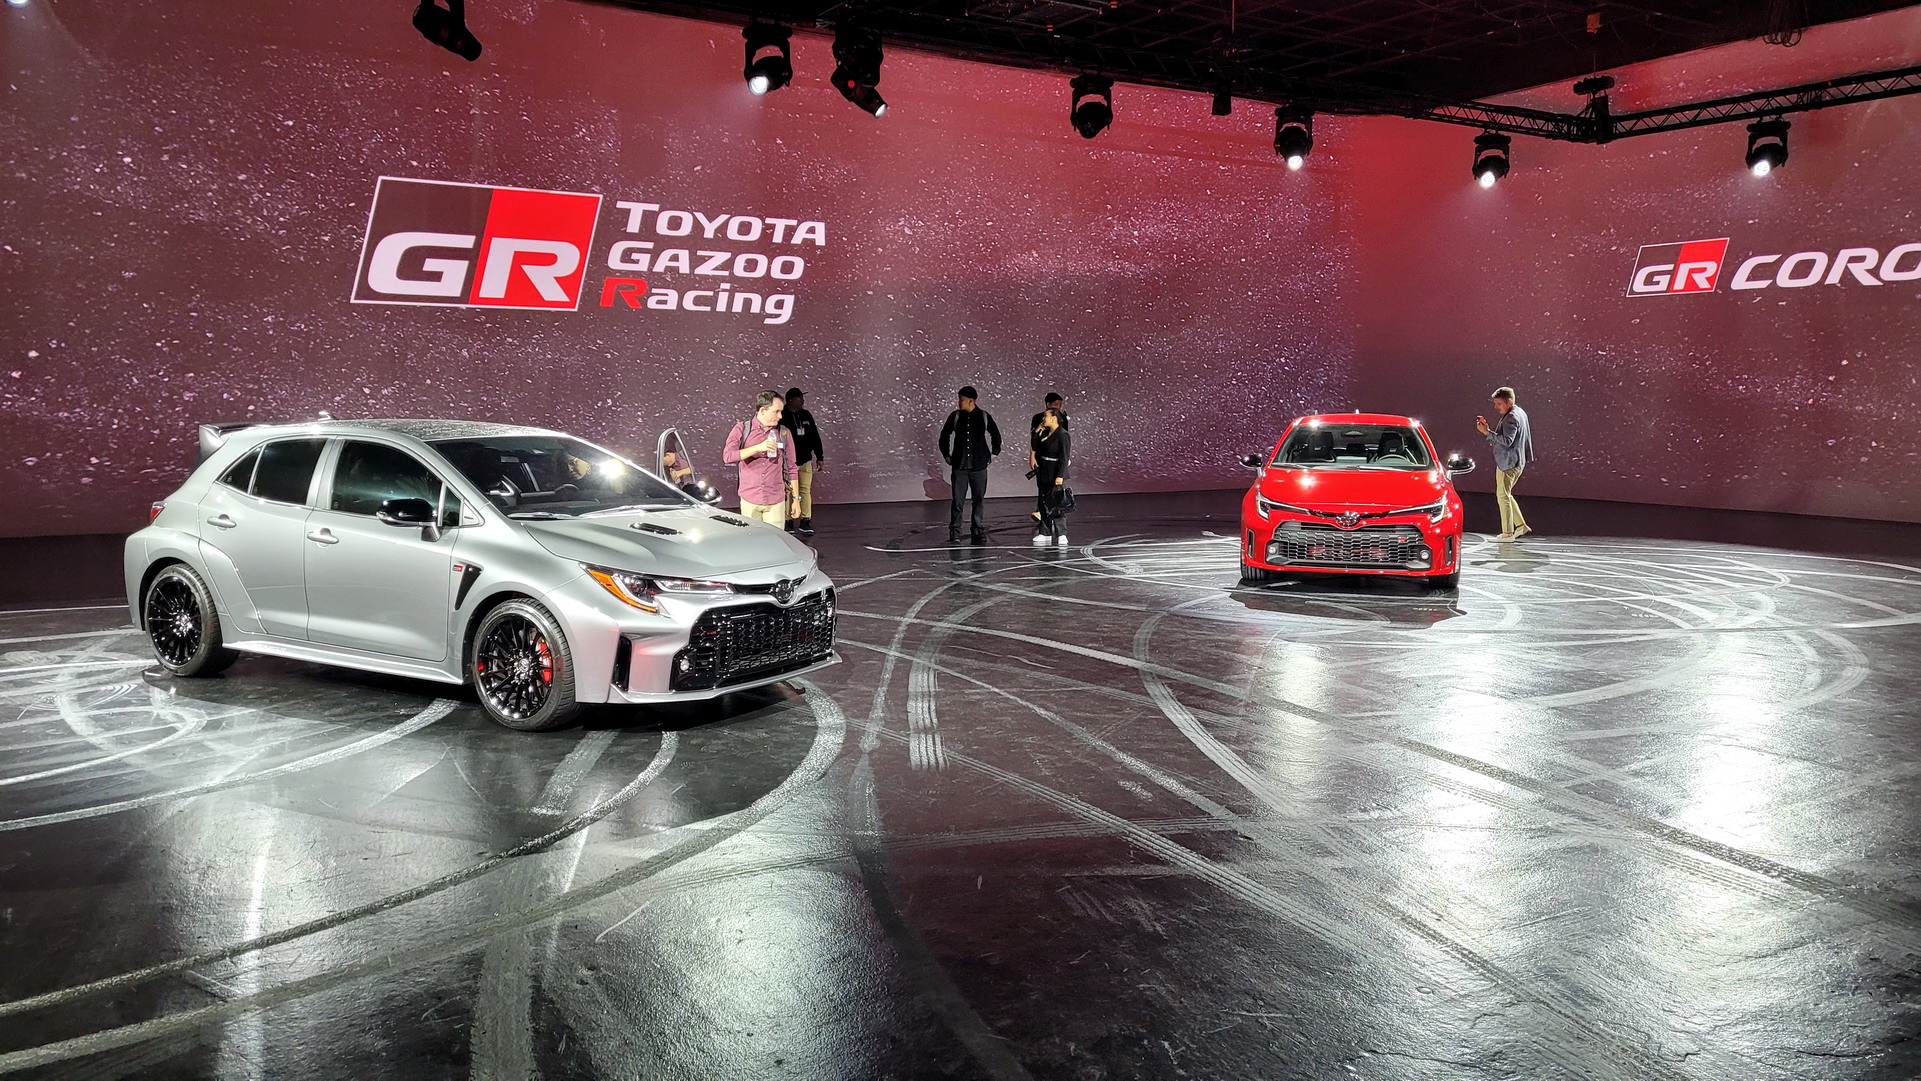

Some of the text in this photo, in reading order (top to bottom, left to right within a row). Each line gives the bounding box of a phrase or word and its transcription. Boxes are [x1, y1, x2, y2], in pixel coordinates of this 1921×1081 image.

[615, 200, 826, 246] TOYOTA
[367, 231, 581, 302] GR
[607, 240, 805, 280] GAZOO
[1632, 242, 1921, 293] GR CORO
[599, 277, 795, 324] Racing
